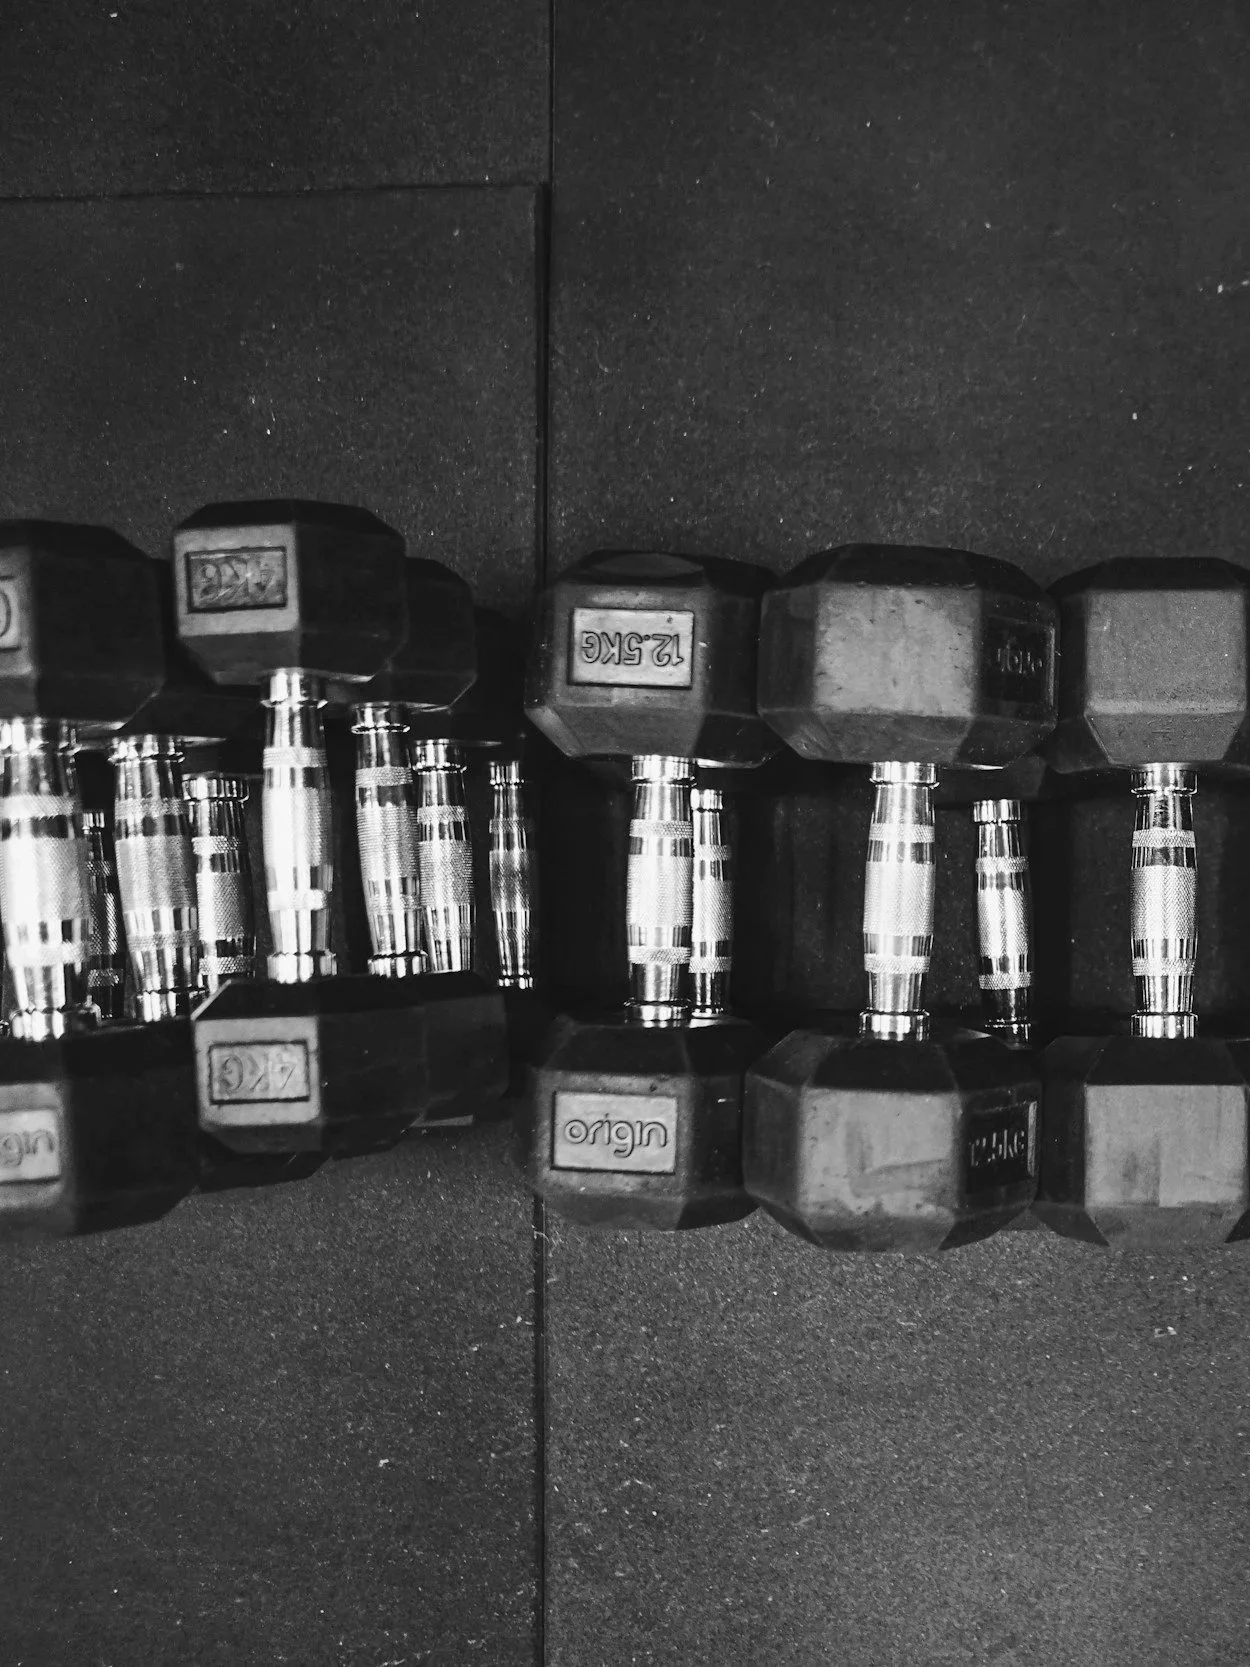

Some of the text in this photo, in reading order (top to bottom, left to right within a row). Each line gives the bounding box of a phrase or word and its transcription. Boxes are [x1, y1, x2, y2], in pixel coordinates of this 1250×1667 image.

[581, 630, 685, 666] 12.5KG
[215, 1054, 304, 1100] 4KG
[564, 1113, 668, 1158] origin
